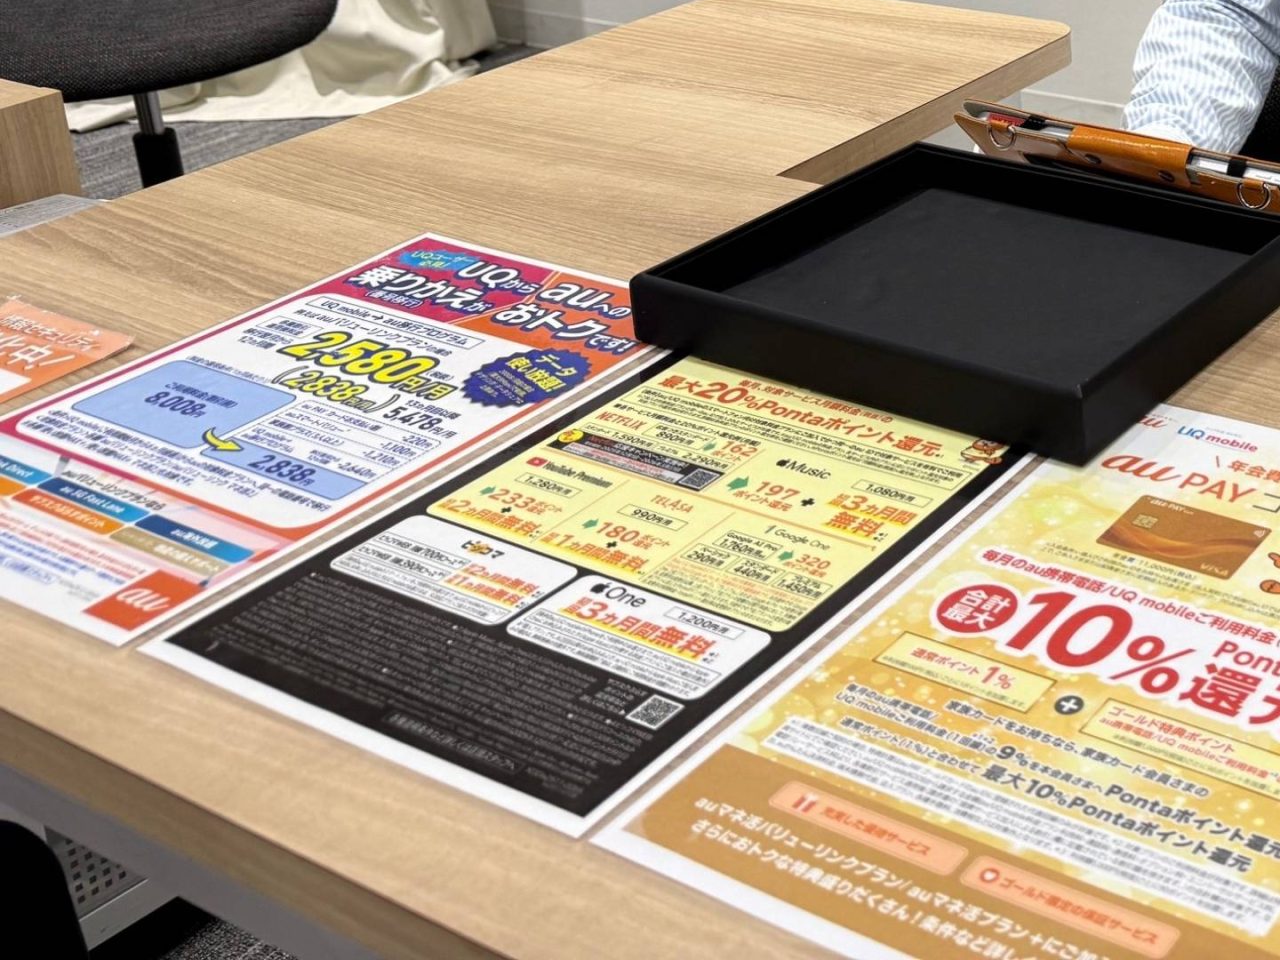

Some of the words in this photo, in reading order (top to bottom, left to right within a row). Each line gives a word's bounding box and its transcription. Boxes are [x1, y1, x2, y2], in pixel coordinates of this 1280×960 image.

[317, 300, 341, 309] UQ
[335, 304, 375, 318] mobile
[349, 265, 495, 314] 乗りかえが
[495, 302, 637, 354] おトクです!
[541, 279, 632, 319] auへの
[139, 390, 216, 419] 8,008円
[379, 405, 468, 438] 5,478円/月
[594, 411, 648, 429] NETFLIX
[716, 440, 760, 457] 162
[1177, 425, 1205, 440] UQ
[1205, 433, 1258, 453] mobile
[539, 461, 580, 477] YouTube
[571, 471, 617, 488] Premium
[785, 460, 835, 478] Music
[1101, 454, 1182, 482] au
[1178, 472, 1256, 503] PAY
[486, 487, 539, 509] 233
[750, 480, 802, 501] 197
[645, 493, 700, 515] TELASA
[590, 520, 643, 543] 180
[770, 528, 812, 545] Google
[823, 510, 886, 538] 無料
[457, 538, 508, 561] ピッコマ
[794, 553, 833, 570] 320
[978, 549, 1139, 602] 毎月のau携帯電話/UQ
[117, 589, 169, 612] au
[600, 584, 653, 609] One
[956, 587, 1014, 614] 合計
[939, 602, 998, 630] 最大
[988, 588, 1216, 695] 10%
